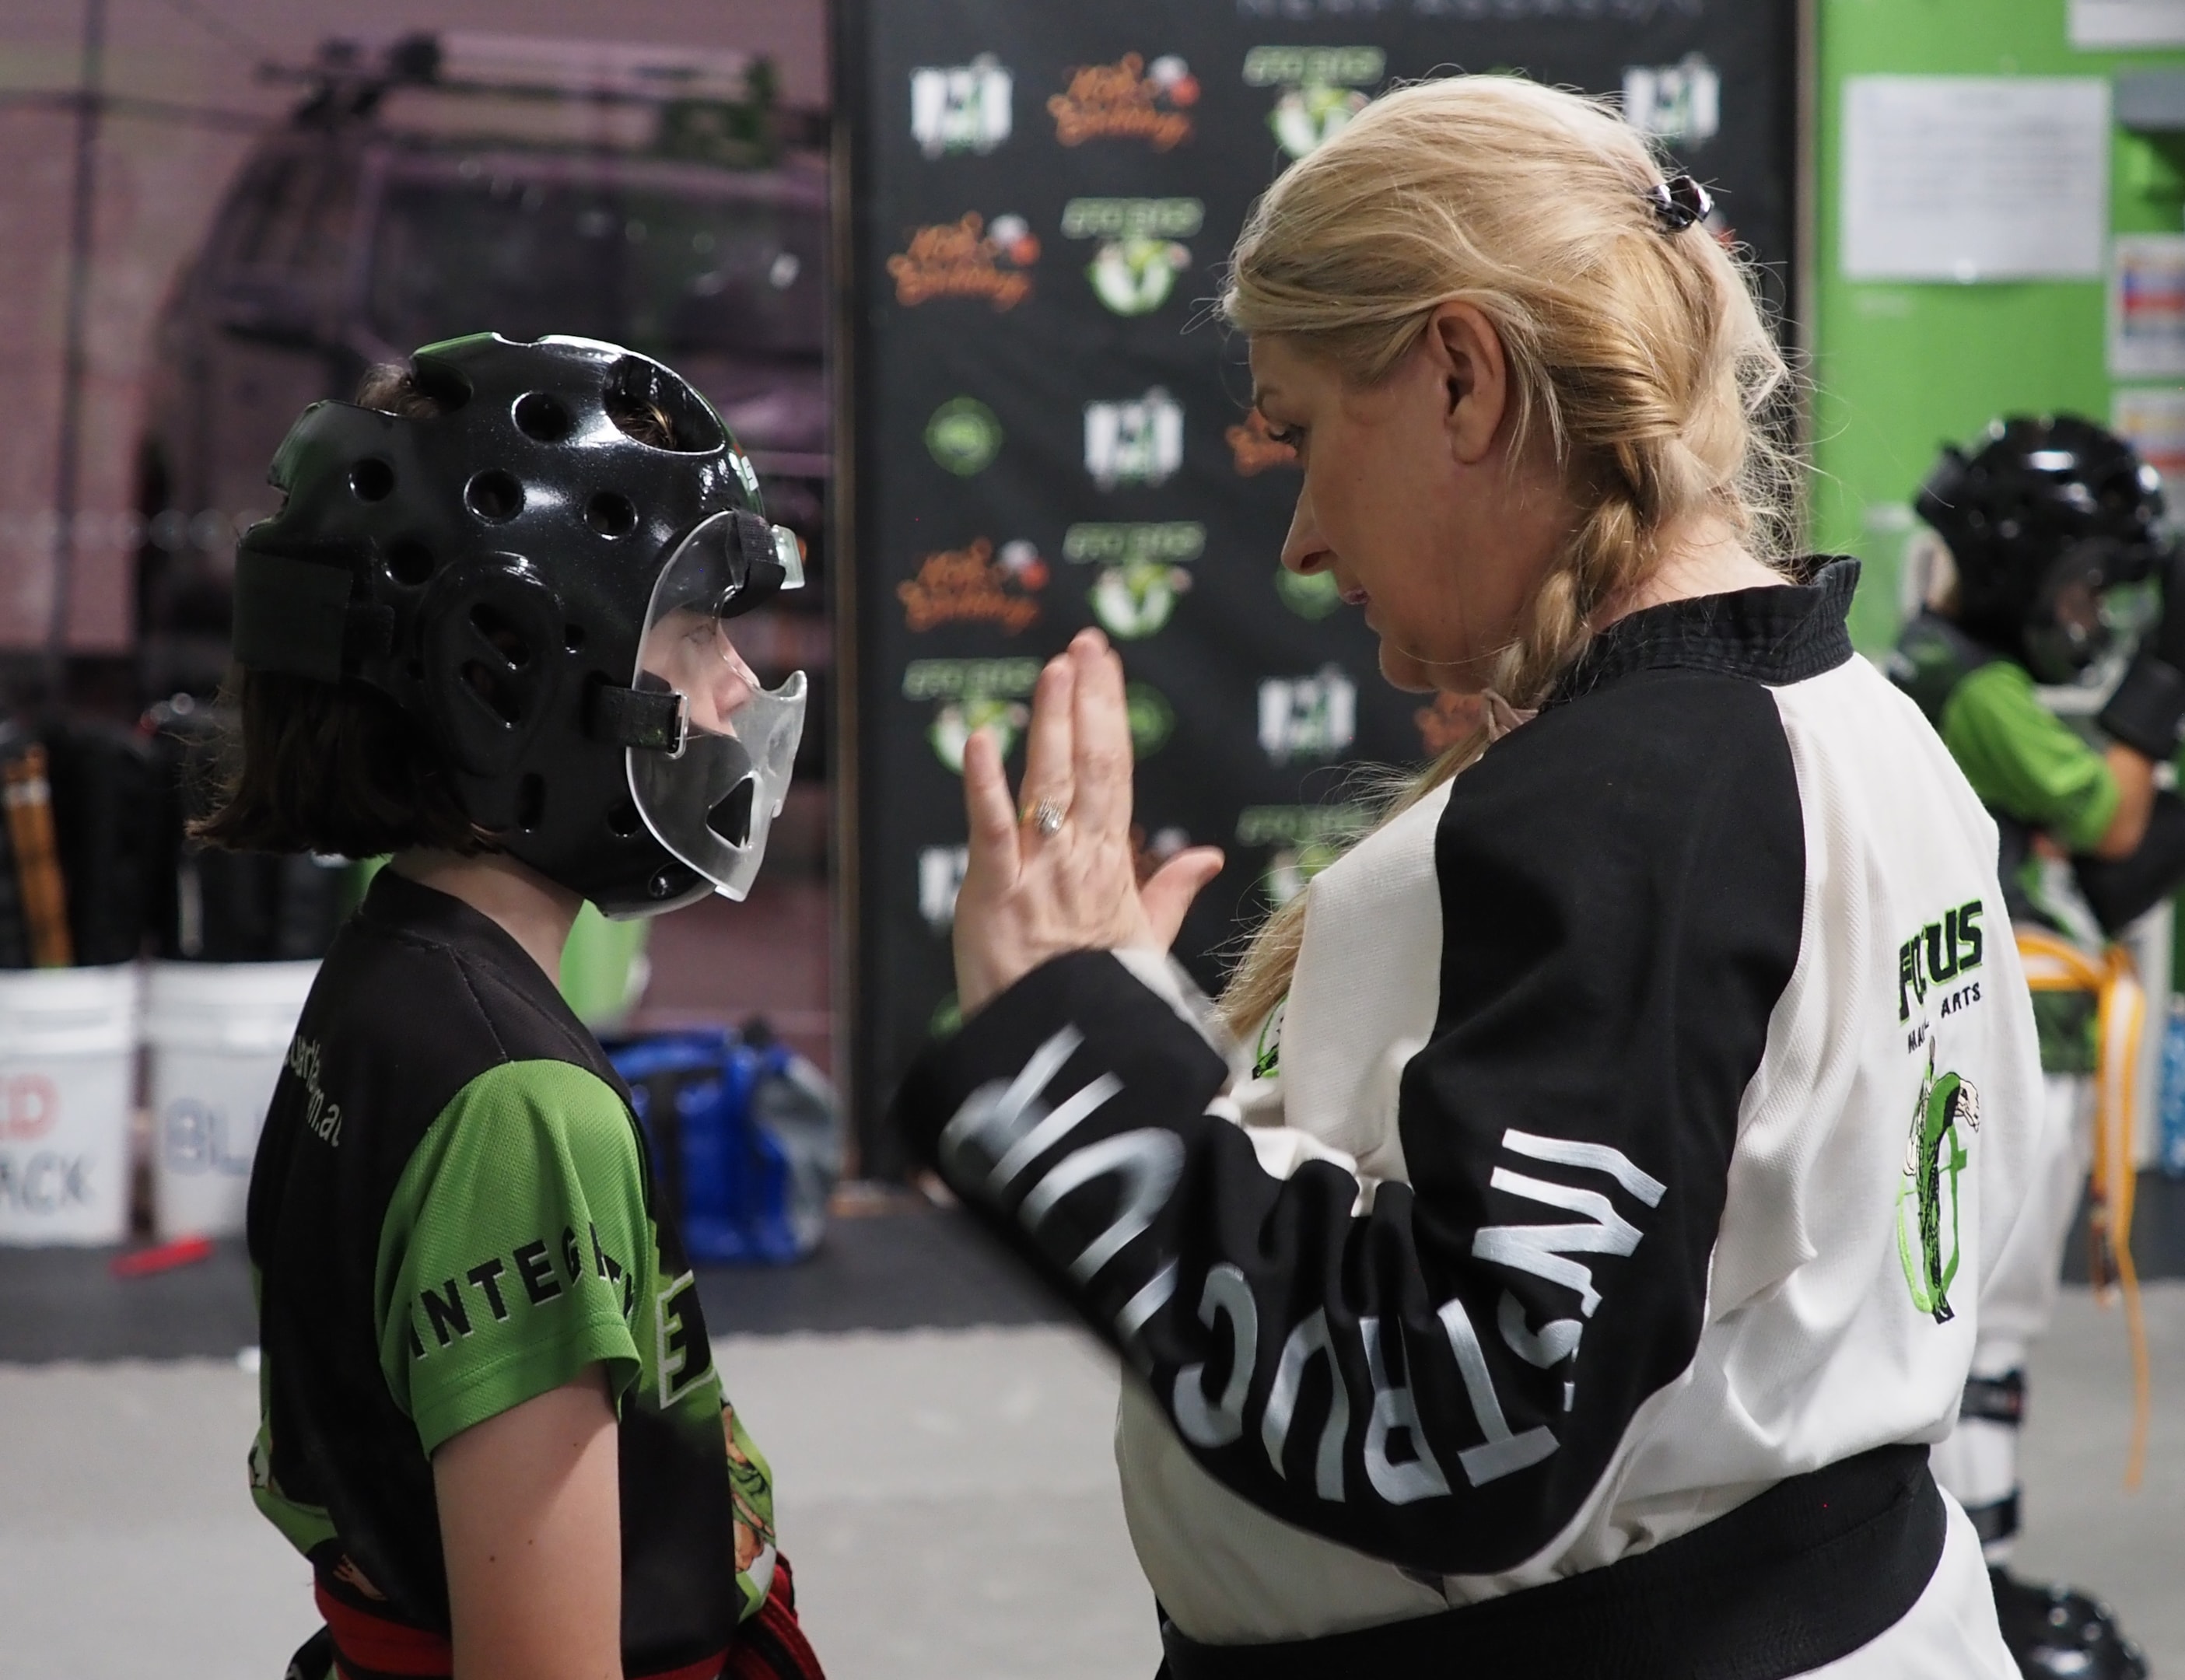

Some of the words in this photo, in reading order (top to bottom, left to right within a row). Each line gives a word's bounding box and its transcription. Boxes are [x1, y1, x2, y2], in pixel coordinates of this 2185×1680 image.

[1898, 899, 1984, 1026] FOUS
[1941, 981, 1981, 1019] ARTS
[164, 1097, 268, 1178] BL
